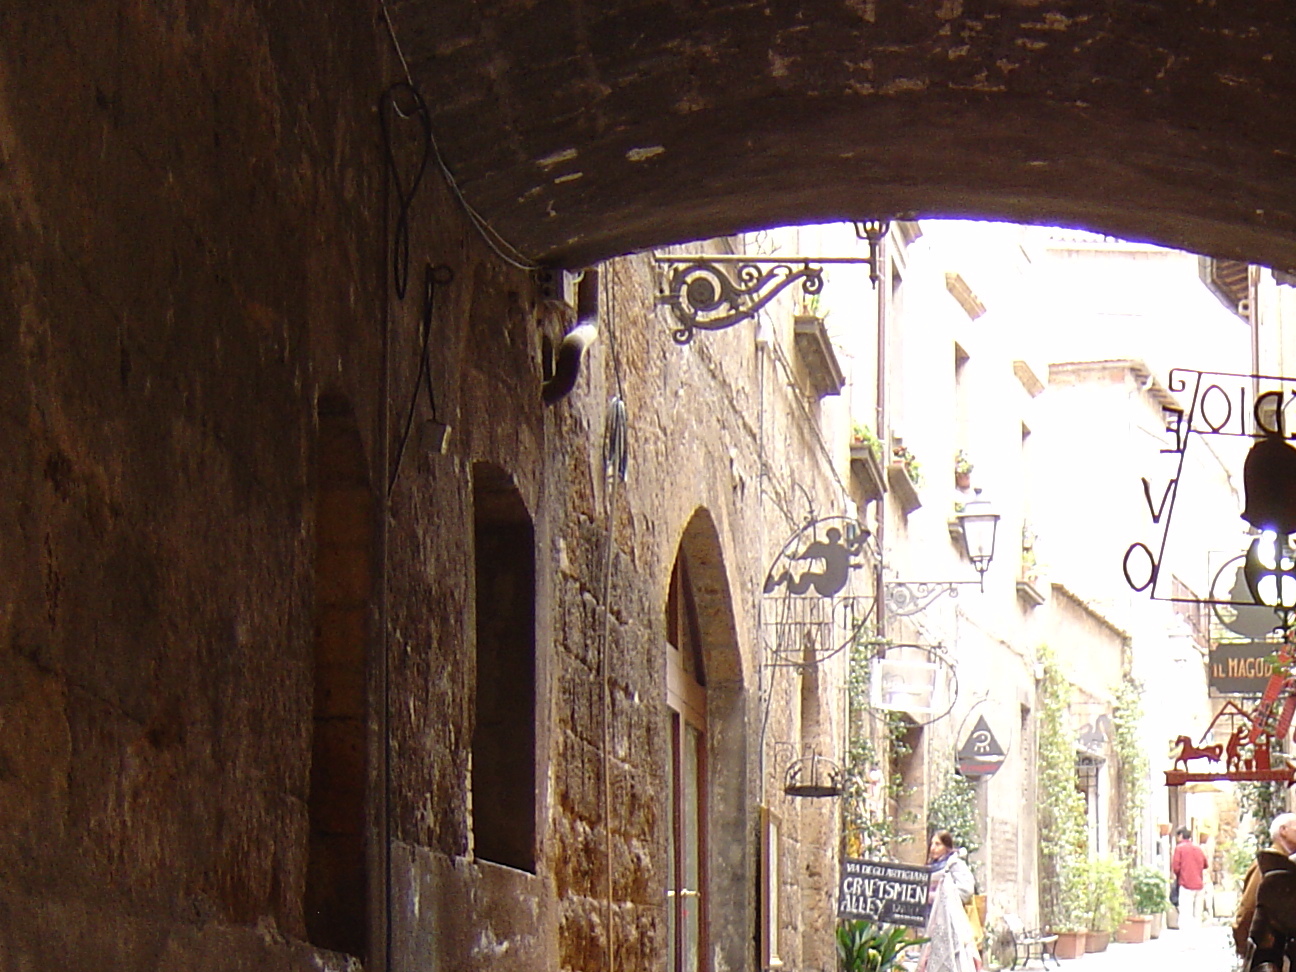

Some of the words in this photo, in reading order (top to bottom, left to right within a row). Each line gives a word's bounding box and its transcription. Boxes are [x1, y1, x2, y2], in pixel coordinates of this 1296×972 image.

[1213, 663, 1226, 678] IL
[1227, 657, 1264, 678] MAGO
[846, 863, 860, 874] VIA
[861, 864, 885, 876] DEGLI
[885, 867, 929, 882] ARTIGIANI
[843, 876, 928, 905] CRAFTSMEN
[840, 894, 886, 919] ALLEY
